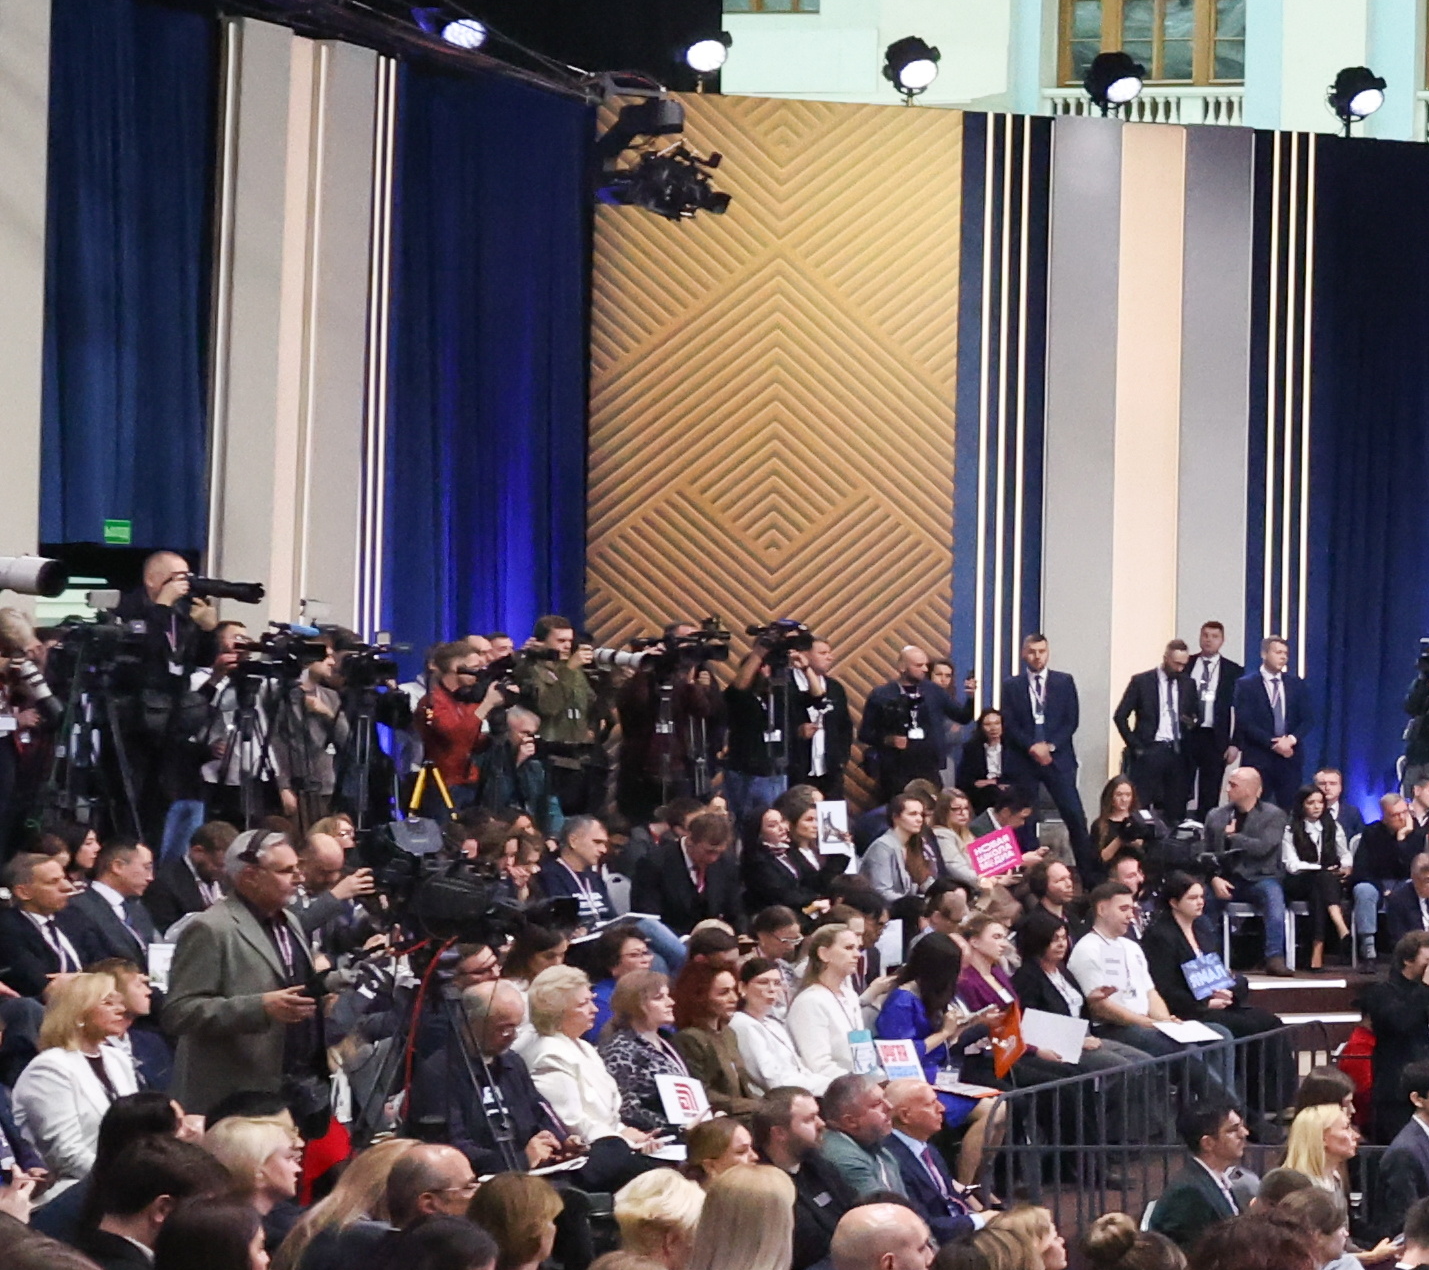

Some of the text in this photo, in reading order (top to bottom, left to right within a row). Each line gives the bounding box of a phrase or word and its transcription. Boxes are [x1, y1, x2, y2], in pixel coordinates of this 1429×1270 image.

[973, 834, 1011, 856] НОВАЯ
[976, 842, 1013, 864] ШКОЛА
[979, 850, 1016, 872] МЕДИА
[1188, 964, 1228, 988] ЯМАЛ
